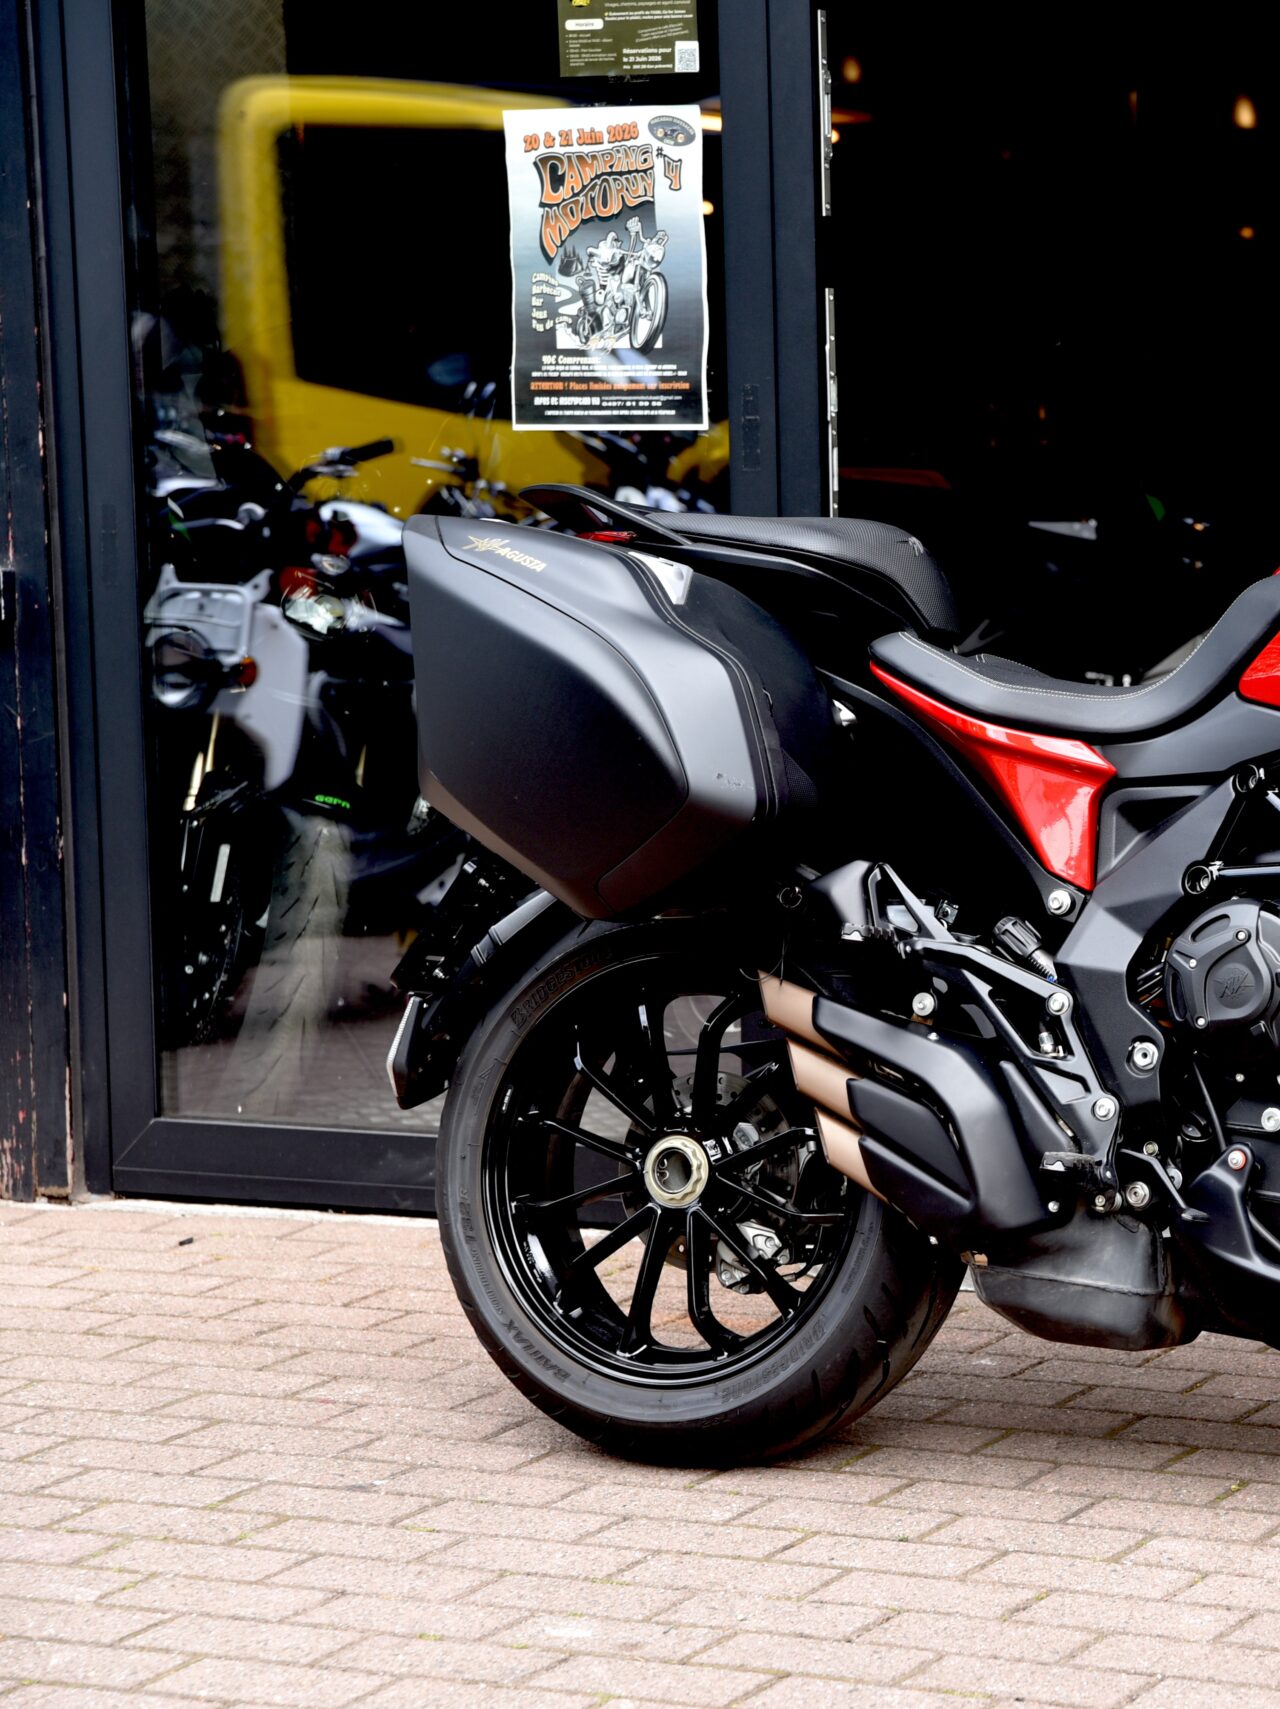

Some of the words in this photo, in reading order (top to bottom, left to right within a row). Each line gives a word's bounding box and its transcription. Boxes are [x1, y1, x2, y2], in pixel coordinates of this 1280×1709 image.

[523, 132, 540, 153] 20
[543, 131, 556, 148] &
[559, 128, 574, 148] 21
[576, 126, 604, 146] Juin
[607, 121, 640, 143] 2026
[541, 170, 655, 259] MOTORUN
[495, 547, 547, 573] AGUSTA
